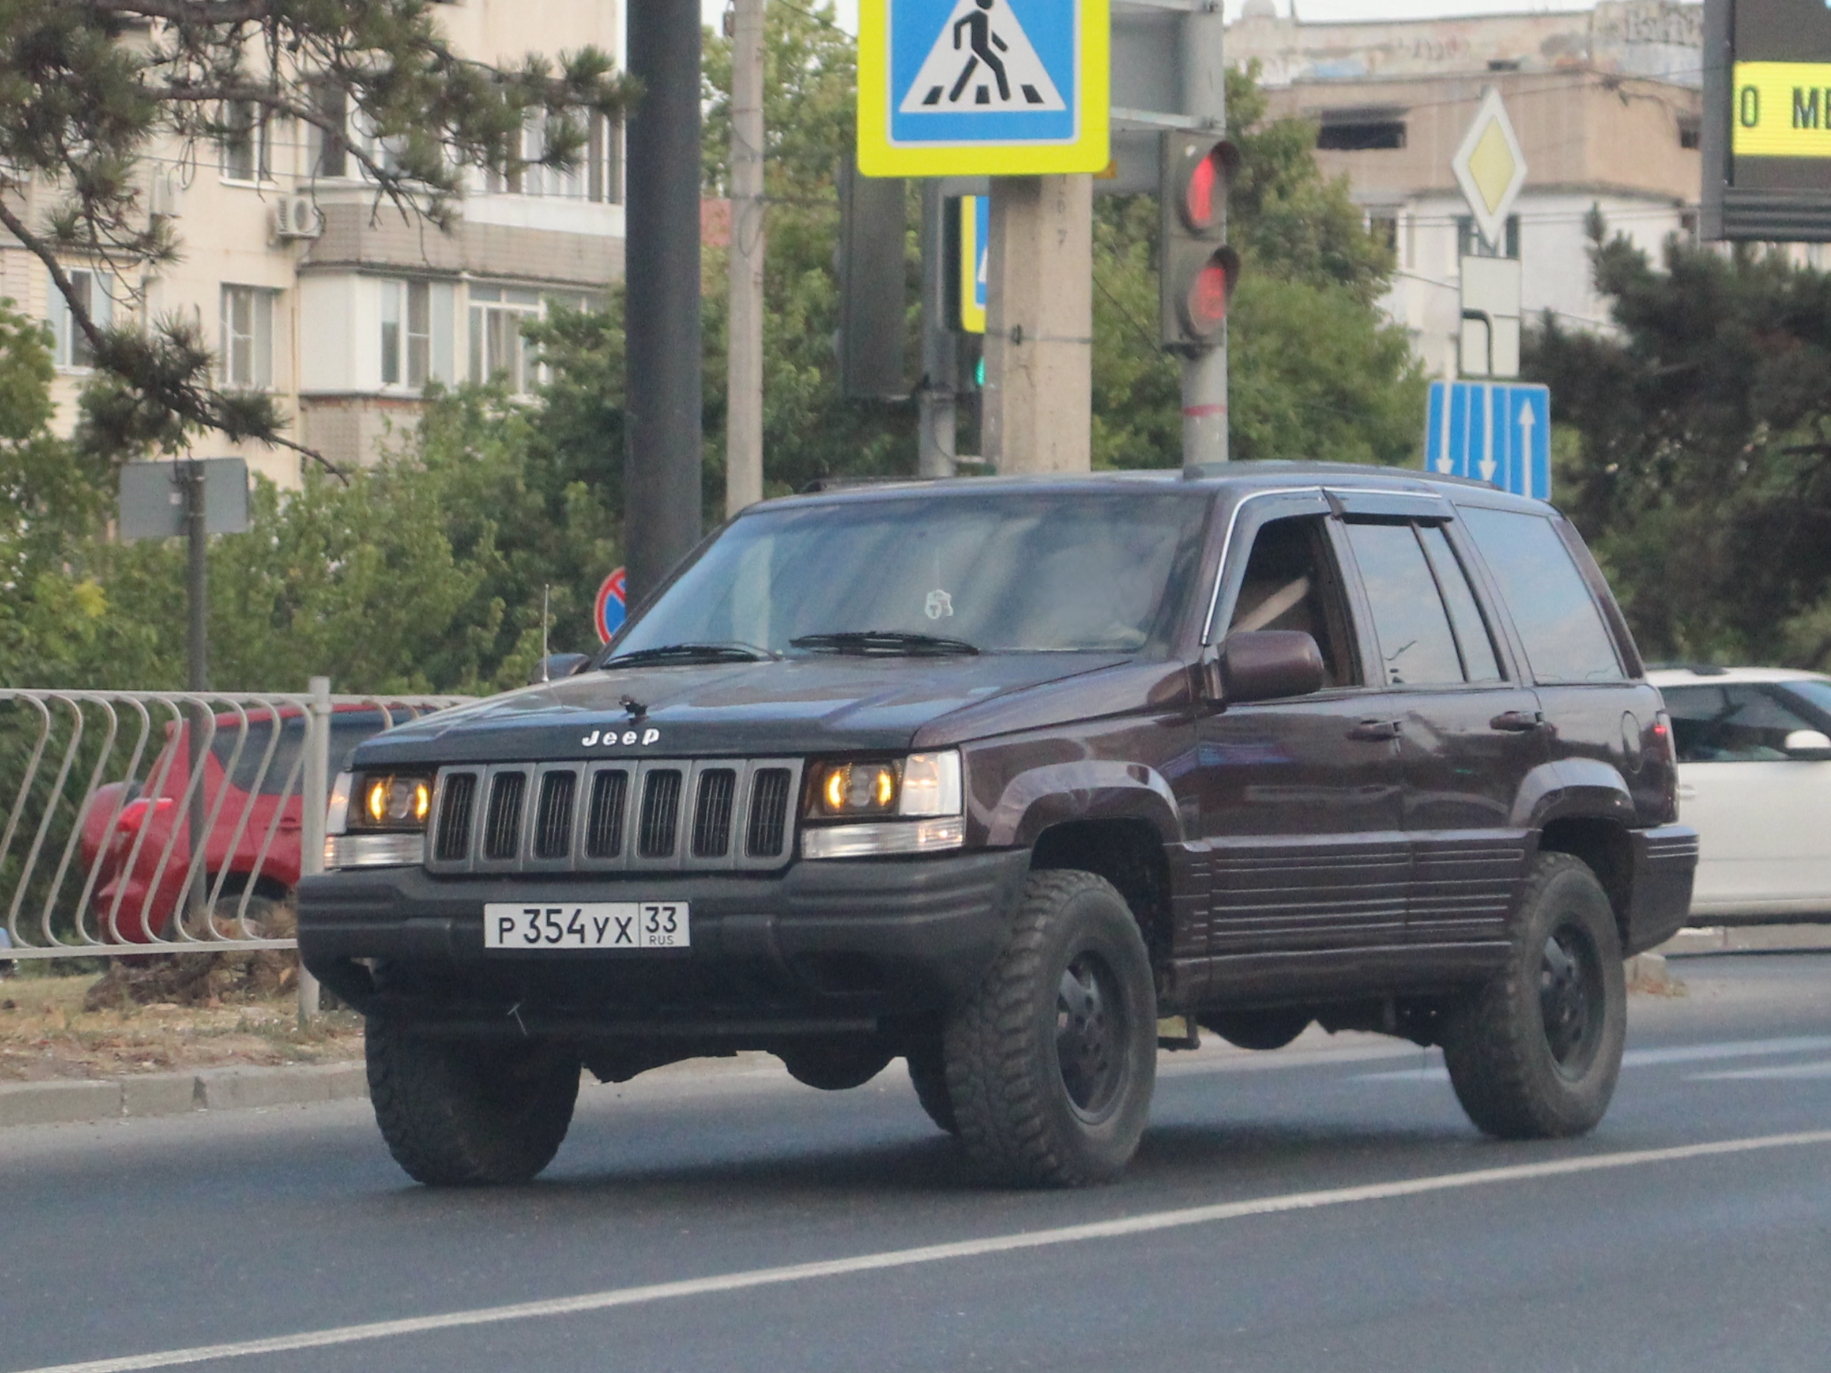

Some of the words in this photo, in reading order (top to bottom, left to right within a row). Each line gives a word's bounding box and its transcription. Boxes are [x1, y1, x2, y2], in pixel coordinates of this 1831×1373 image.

[581, 728, 660, 747] Jeep
[499, 908, 632, 944] Р354УХ
[645, 906, 677, 933] 33
[649, 935, 674, 946] RUS
